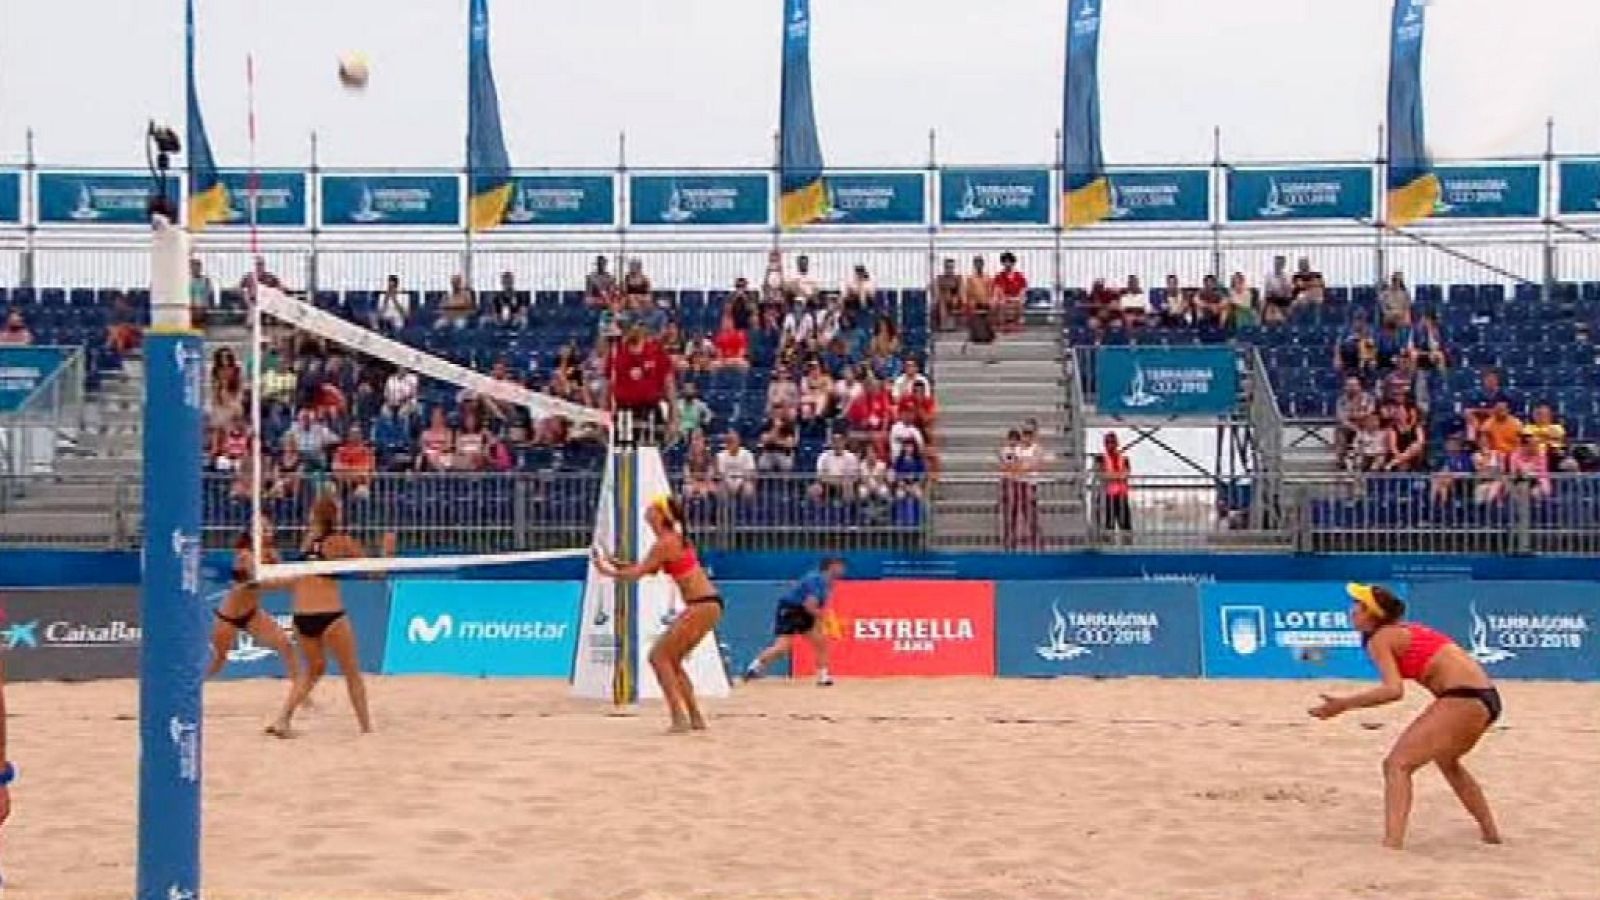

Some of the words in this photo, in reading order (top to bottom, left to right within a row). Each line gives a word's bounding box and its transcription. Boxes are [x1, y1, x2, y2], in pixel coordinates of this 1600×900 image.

[1067, 612, 1159, 626] TARRAGONA
[1274, 611, 1349, 629] LOTER
[1487, 615, 1586, 629] TARRAGONA
[459, 621, 568, 640] movistar
[854, 618, 974, 639] ESTRELLA
[1114, 630, 1152, 644] 2018
[1541, 633, 1580, 648] 2018
